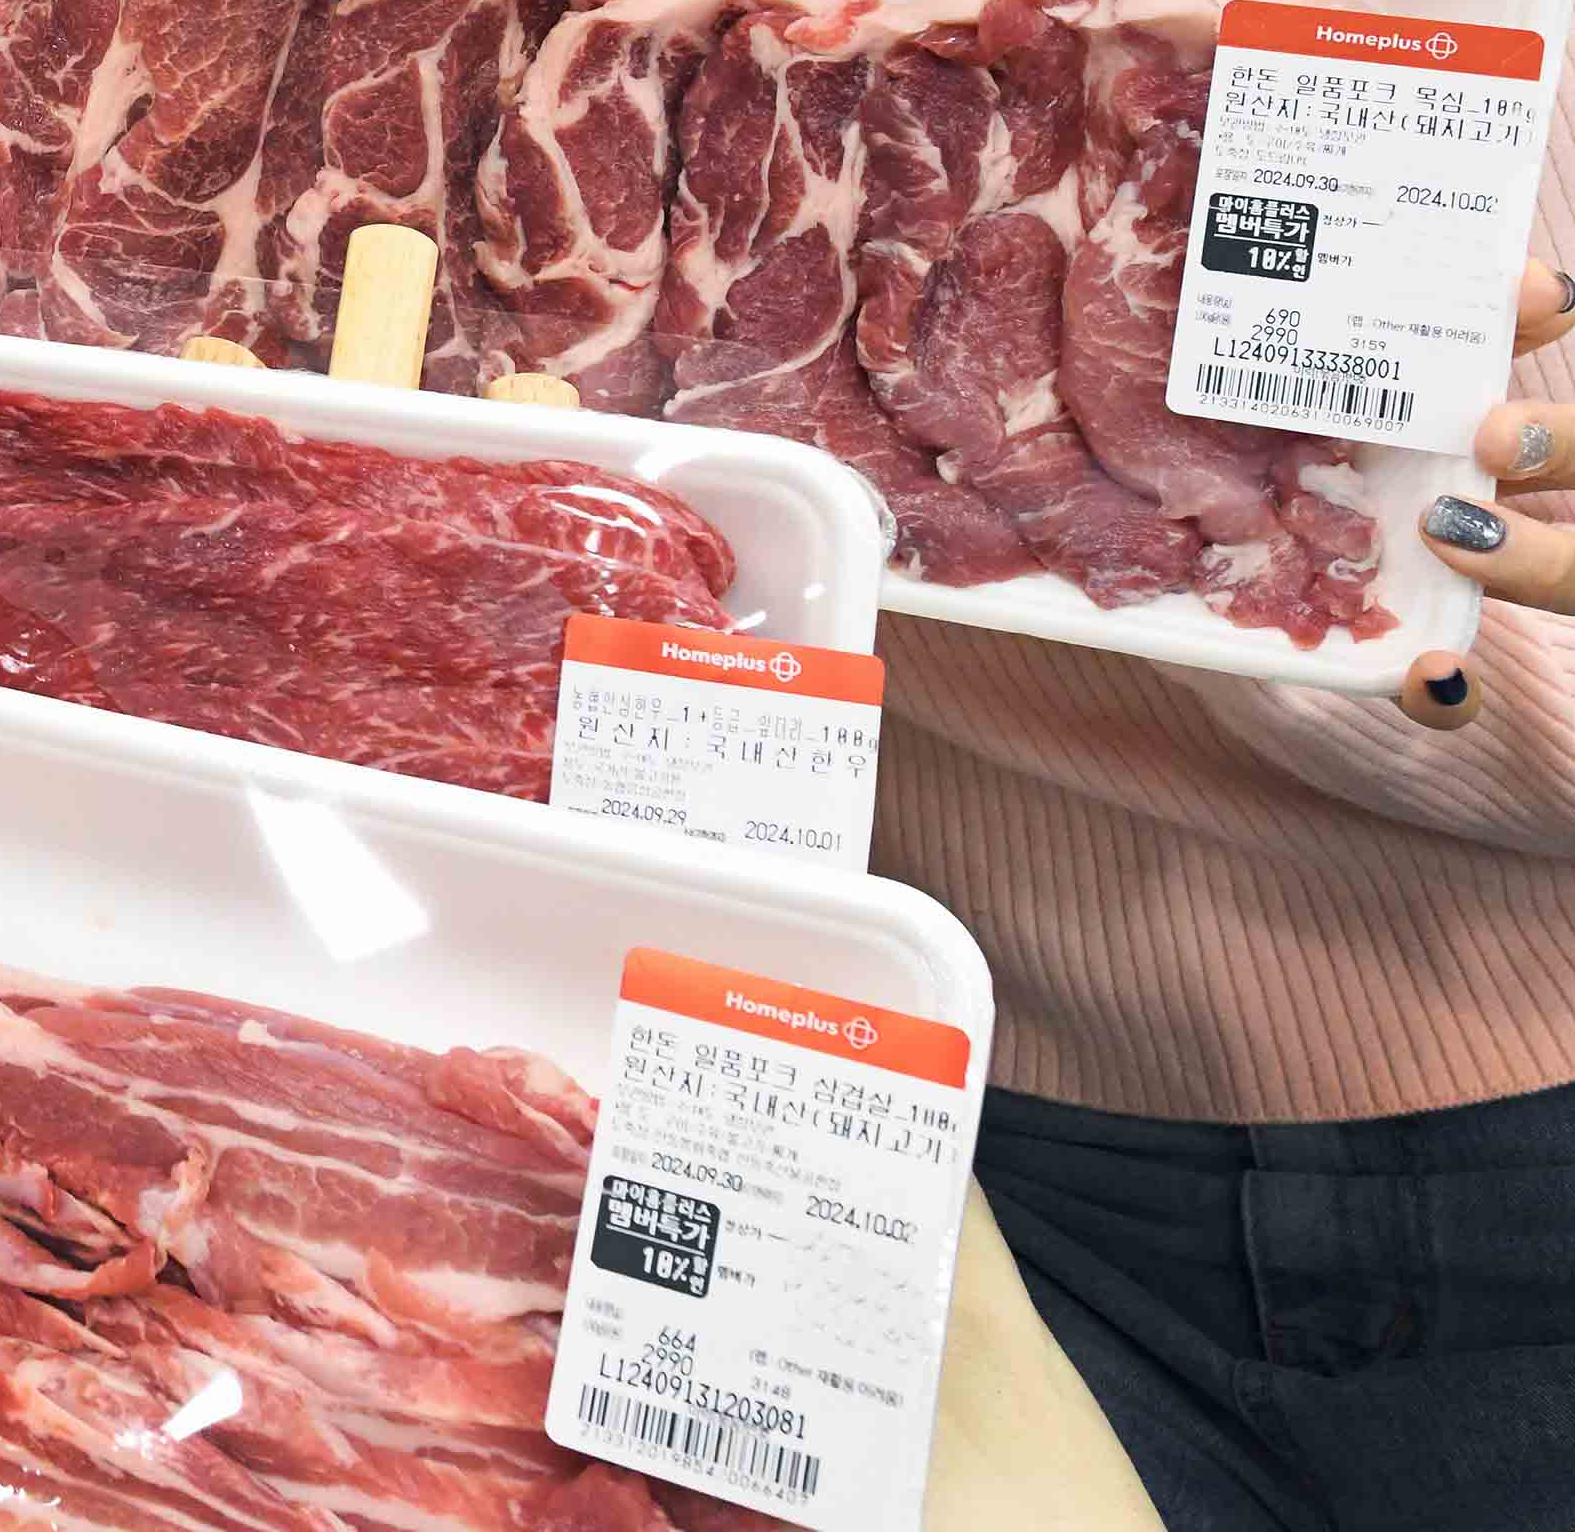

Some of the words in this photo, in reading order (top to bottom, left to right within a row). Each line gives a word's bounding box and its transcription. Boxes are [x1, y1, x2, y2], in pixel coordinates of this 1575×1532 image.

[1315, 24, 1423, 53] Homeplus
[1231, 65, 1278, 91] 한돈
[1296, 73, 1397, 105] 일품포크
[1252, 167, 1339, 193] 2024.09.30
[1218, 195, 1311, 221] 마이홈플러스
[1215, 213, 1311, 243] 멤버특가
[1264, 307, 1301, 328] 690
[1250, 324, 1299, 346] 2990
[1350, 337, 1388, 352] 3159
[1213, 335, 1401, 381] L12409133338001
[661, 641, 767, 673] Homeplus
[601, 798, 688, 827] 2024.09.29
[744, 820, 843, 853] 2024.10.01
[724, 988, 840, 1038] Homeplus
[629, 1023, 680, 1061] 한돈
[651, 1151, 744, 1193] 2024.09.30
[657, 1325, 698, 1354] 664
[641, 1342, 695, 1378] 2990
[599, 1352, 807, 1440] L12409131203081
